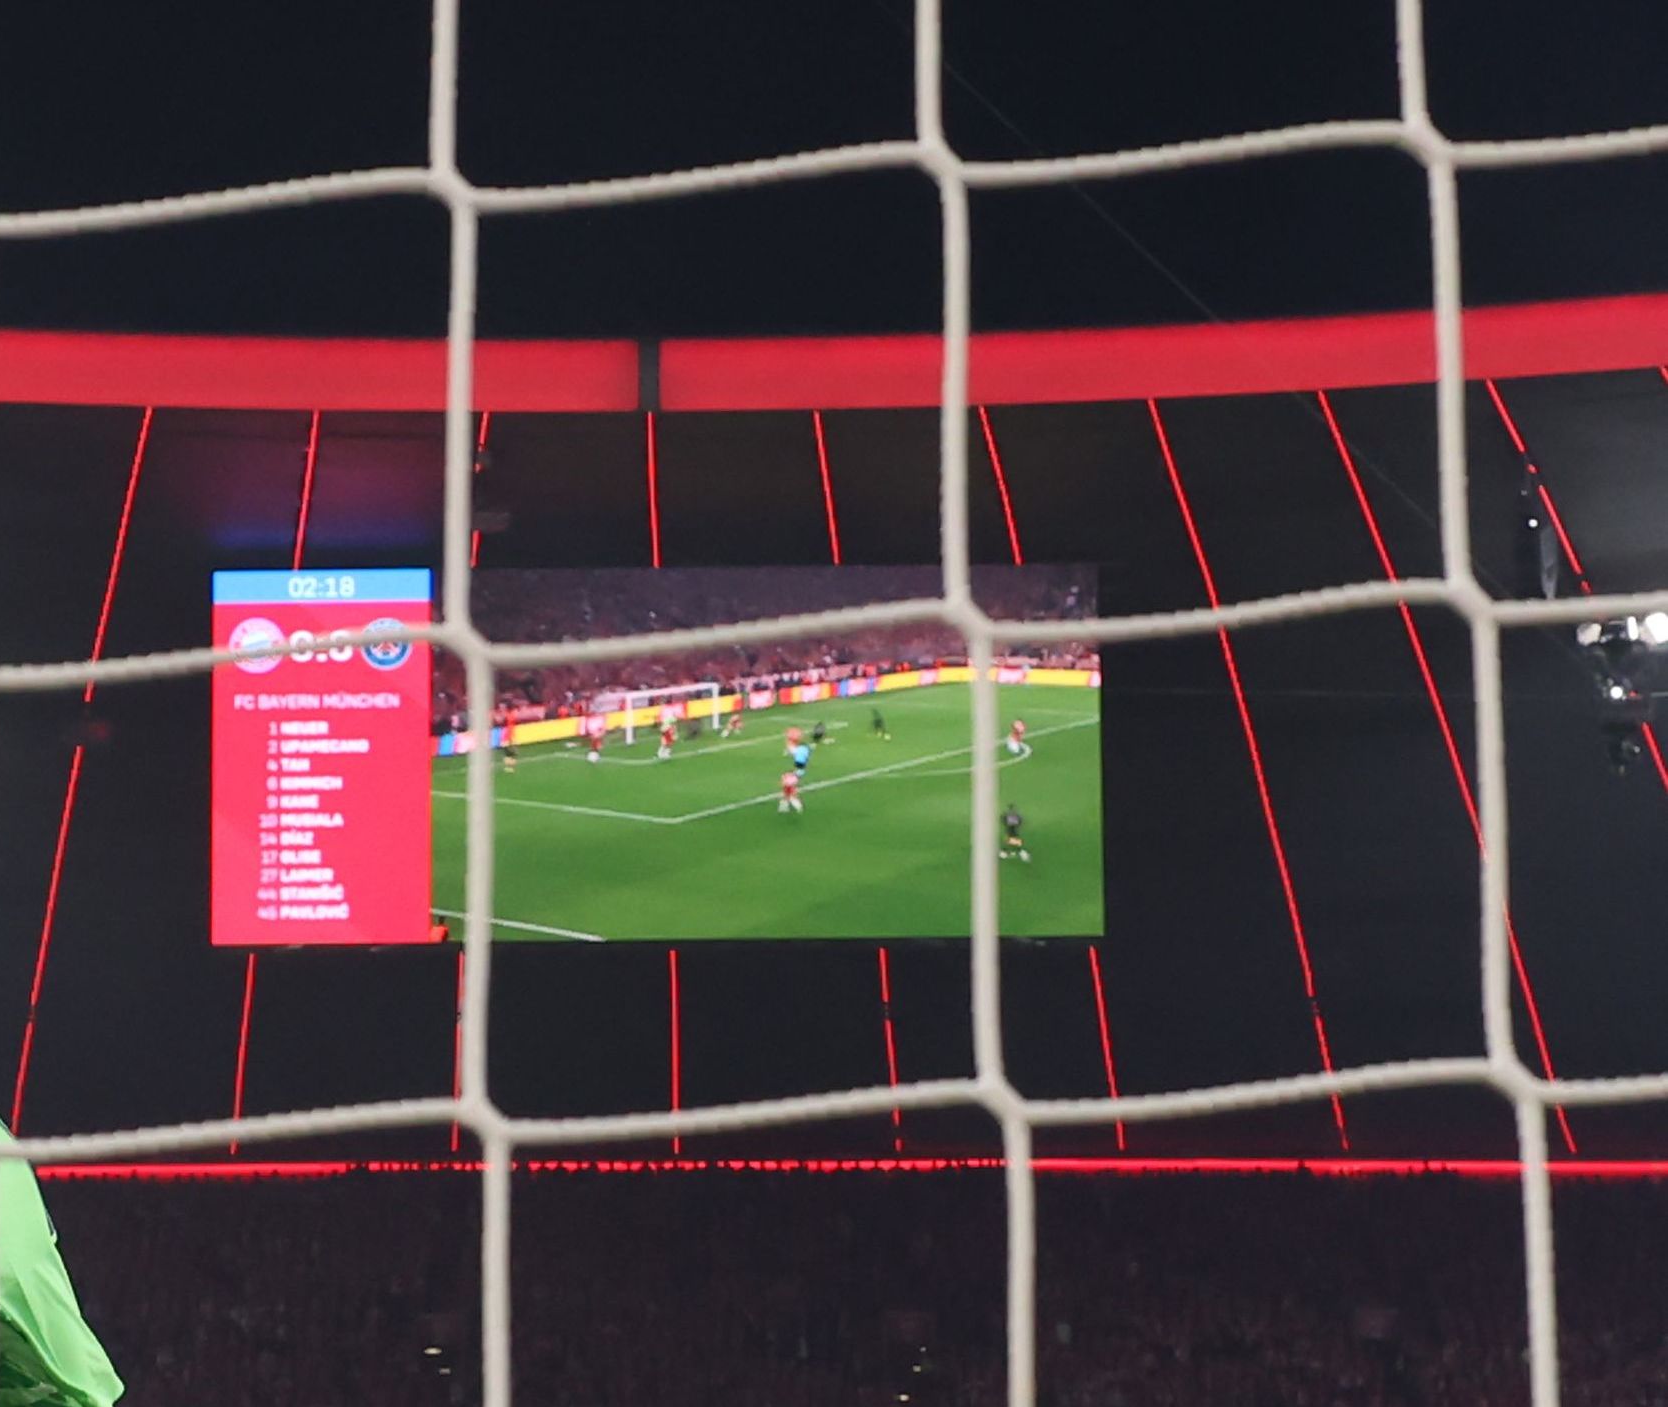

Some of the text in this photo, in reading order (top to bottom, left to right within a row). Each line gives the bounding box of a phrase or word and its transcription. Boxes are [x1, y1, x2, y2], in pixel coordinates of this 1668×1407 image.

[288, 577, 354, 598] 02:18
[233, 691, 400, 709] FC BAYERN MÜNCHEN
